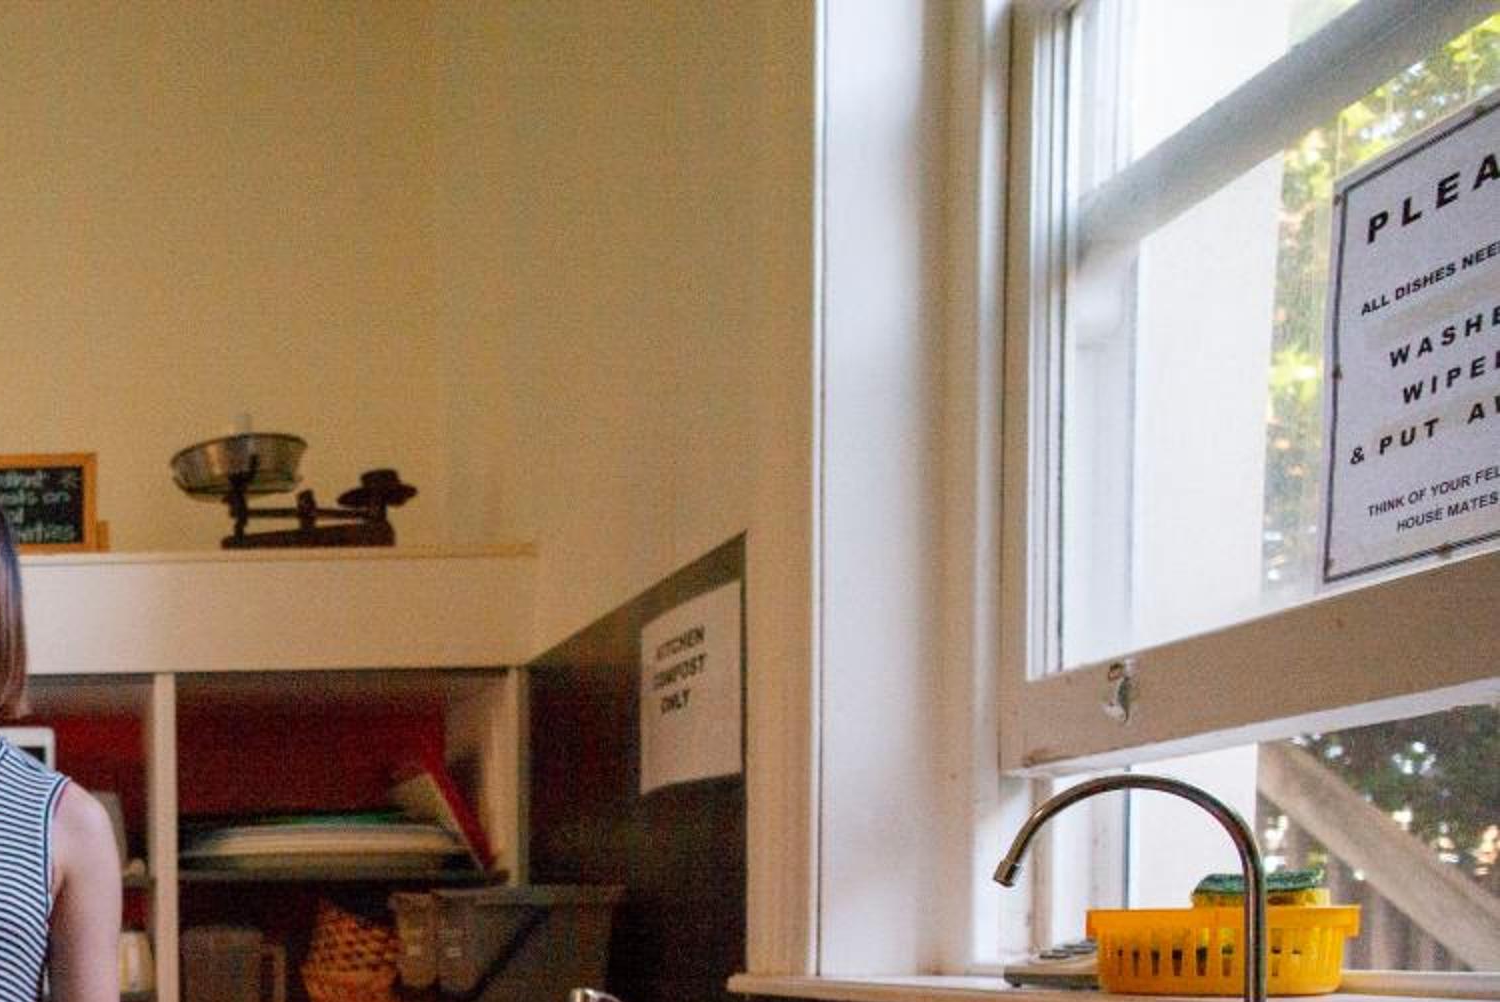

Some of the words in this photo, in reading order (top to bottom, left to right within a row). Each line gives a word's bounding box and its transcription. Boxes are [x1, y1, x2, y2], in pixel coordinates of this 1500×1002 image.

[1361, 295, 1390, 316] ALL
[1395, 262, 1457, 301] DISHES
[1461, 240, 1500, 270] NEE
[1403, 350, 1500, 404] WIPE
[1349, 446, 1365, 465] &
[1379, 417, 1439, 456] PUT
[1367, 495, 1405, 517] THINK
[1407, 487, 1427, 504] OF
[1431, 473, 1472, 496] YOUR
[1396, 507, 1444, 533] HOUSE
[1447, 491, 1499, 517] MATES
